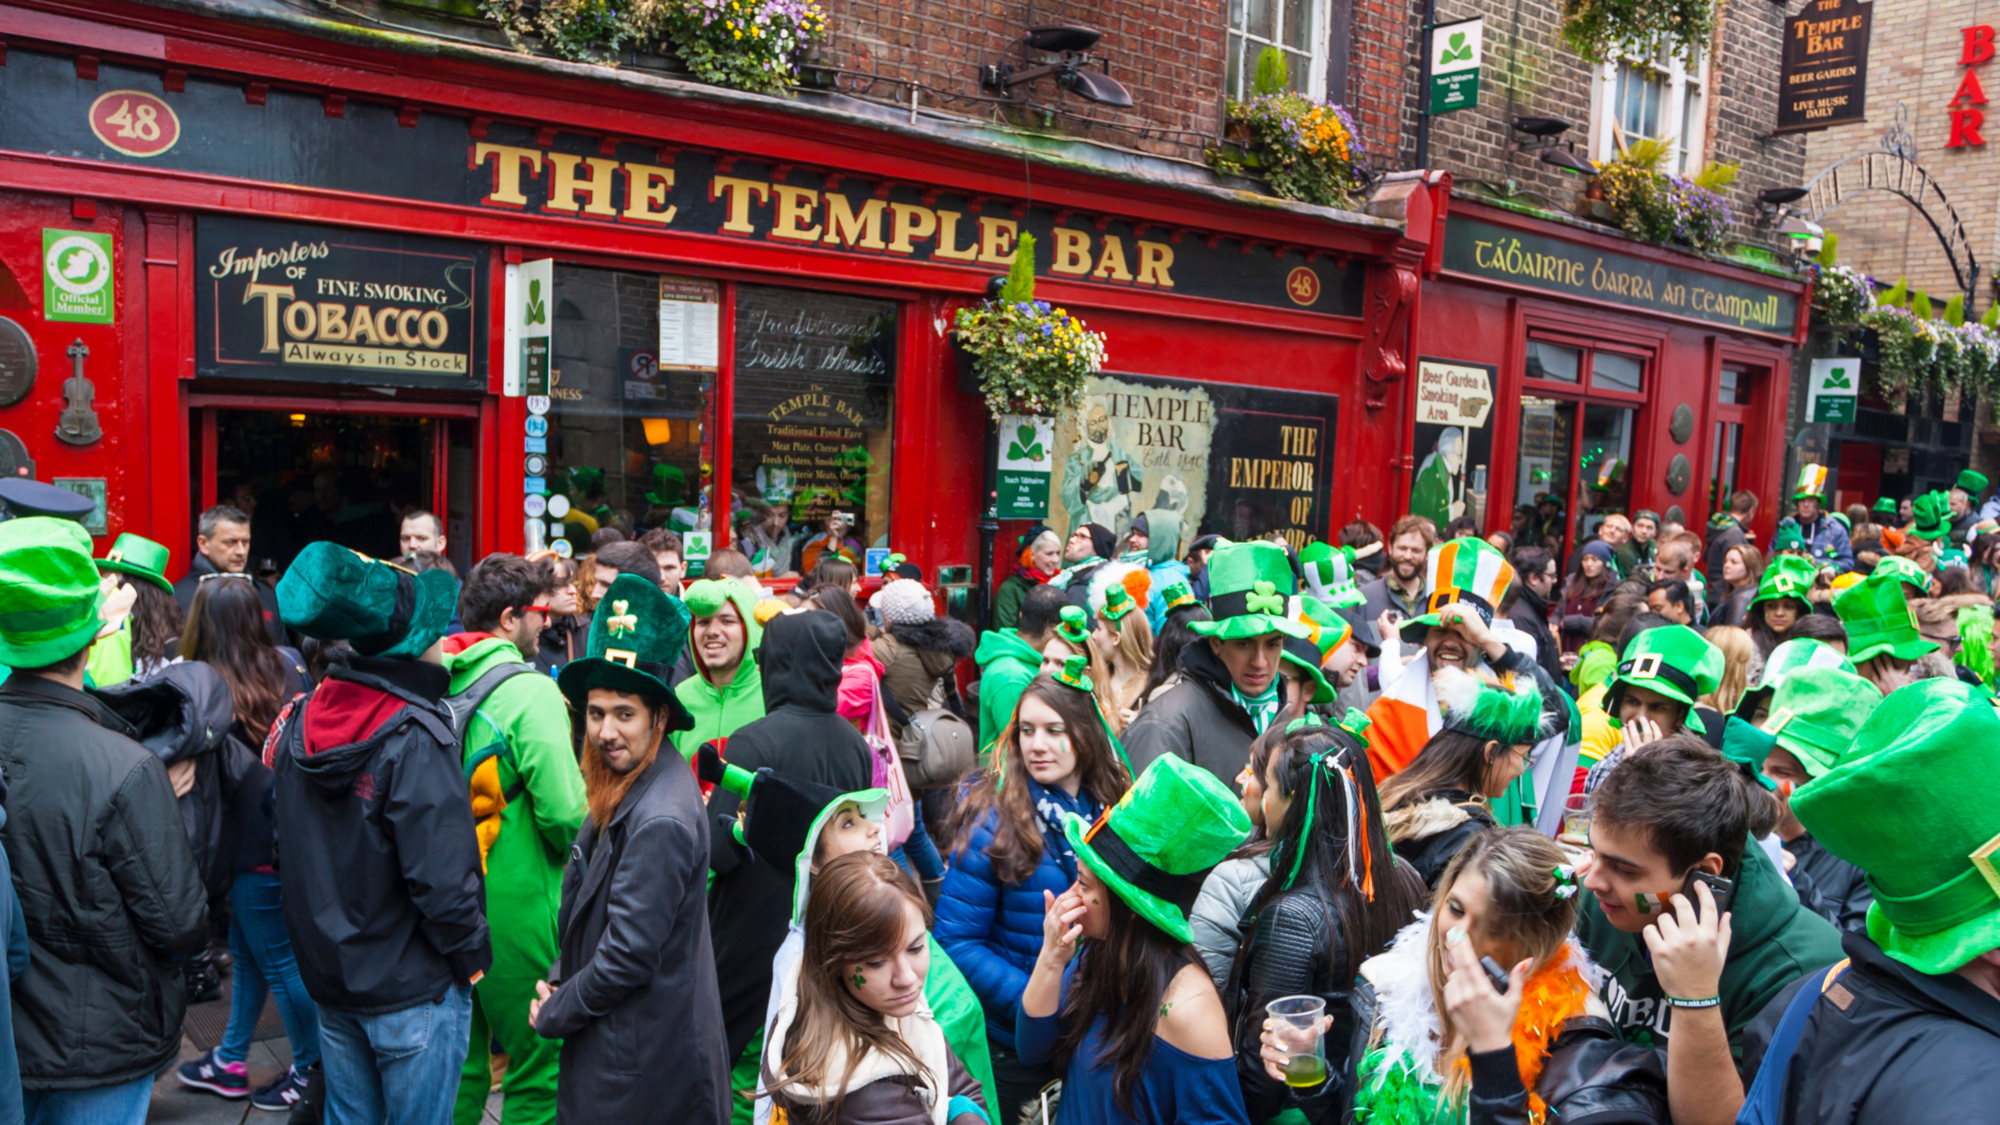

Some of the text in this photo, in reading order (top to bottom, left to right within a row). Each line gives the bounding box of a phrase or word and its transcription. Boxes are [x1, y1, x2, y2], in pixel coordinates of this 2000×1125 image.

[1817, 0, 1842, 11] THE
[1793, 15, 1862, 39] TEMPLE
[1806, 35, 1844, 55] BAR
[1789, 66, 1857, 84] BEER GARDEN
[1944, 25, 1996, 148] BAR
[1793, 95, 1849, 111] LIVE MUSIC
[1805, 107, 1834, 119] DAILY
[105, 99, 160, 142] 48
[472, 141, 1175, 288] THE TEMPLE BAR
[209, 240, 330, 282] Importers
[286, 266, 308, 280] OF
[316, 278, 448, 305] FINE SMOKING
[678, 285, 701, 293] TEMPLE
[1291, 272, 1313, 298] 48
[57, 302, 102, 314] Member
[60, 293, 99, 305] Official
[242, 282, 450, 355] TOBACCO
[757, 309, 881, 338] Traditional
[288, 344, 464, 371] Always in Stock
[821, 346, 886, 375] Music
[810, 384, 823, 392] The
[1422, 366, 1443, 384] Beer
[1446, 370, 1479, 390] Garden
[551, 387, 583, 400] NNESS
[1420, 385, 1459, 408] Smoking
[767, 393, 864, 428] TEMPLE BAR
[1106, 392, 1210, 424] TEMPLE
[1427, 404, 1449, 421] Area
[766, 424, 863, 439] Traditional Food Fare
[1137, 422, 1186, 451] BAR
[1280, 425, 1318, 457] THE
[772, 441, 862, 454] Meat Plate, Cheese Board
[762, 454, 782, 465] Fresh
[784, 455, 813, 467] Oysters,
[814, 456, 843, 467] Smoked
[815, 470, 838, 481] Meats,
[840, 470, 861, 480] Olives
[1004, 476, 1020, 484] Teach
[1230, 457, 1315, 492] EMPEROR
[1018, 485, 1030, 493] Pub
[816, 496, 832, 506] Beef
[834, 496, 852, 507] Rolls
[1290, 496, 1313, 526] OF
